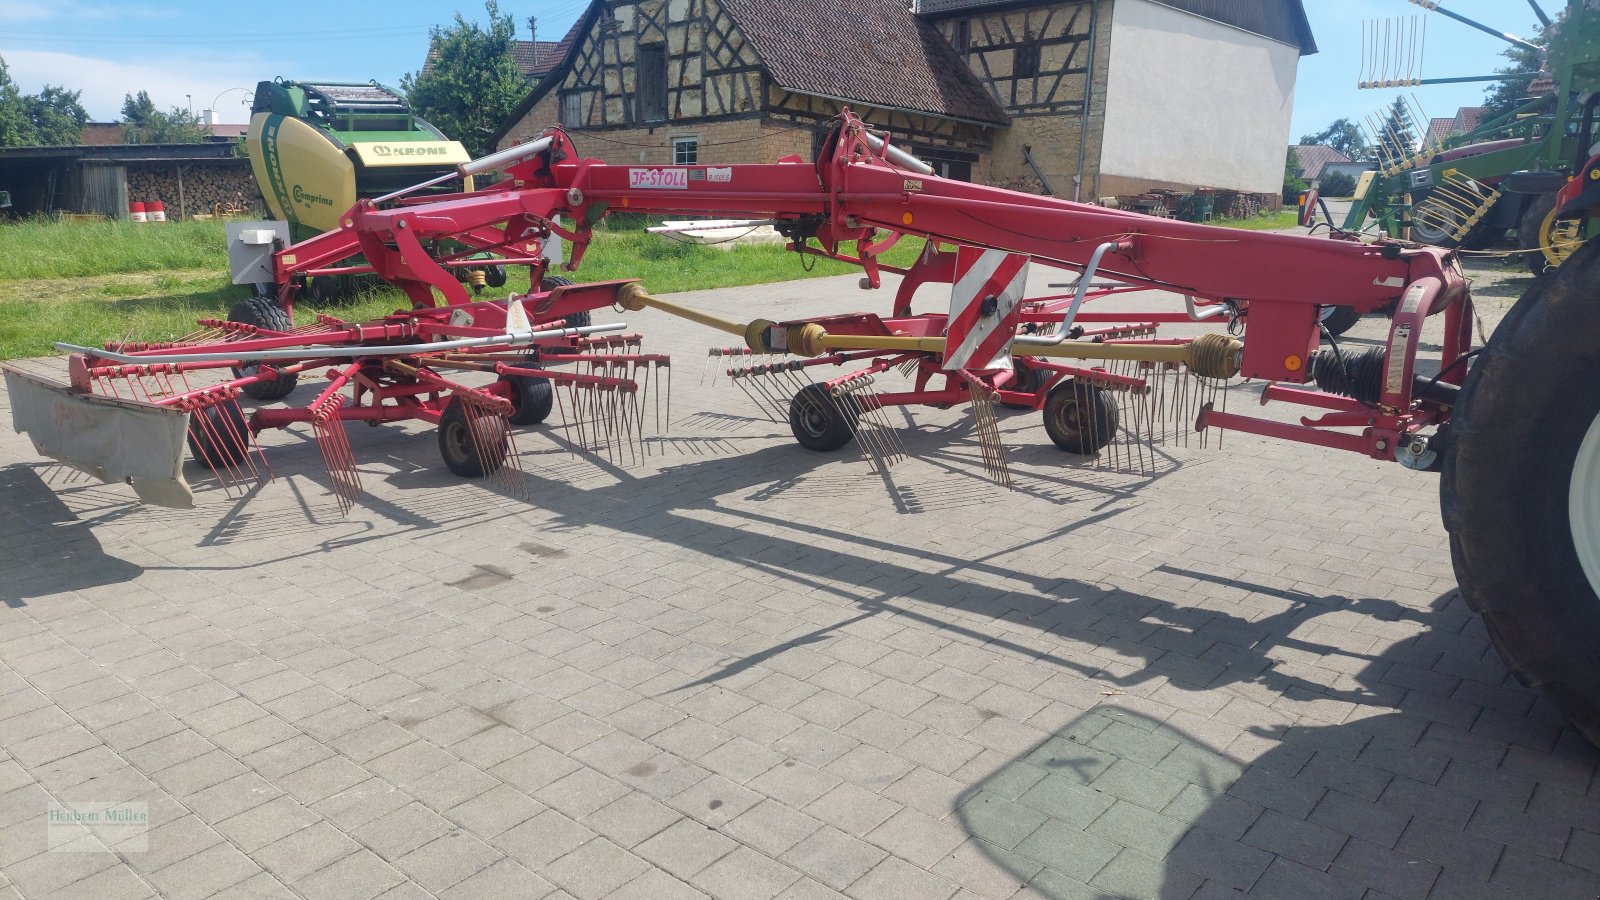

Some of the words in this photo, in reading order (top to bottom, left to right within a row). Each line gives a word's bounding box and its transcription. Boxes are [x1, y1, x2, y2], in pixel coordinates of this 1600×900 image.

[267, 126, 285, 193] KRONE
[394, 147, 447, 156] KRONE
[632, 172, 685, 186] JF-STOLL
[292, 185, 333, 206] Comprima
